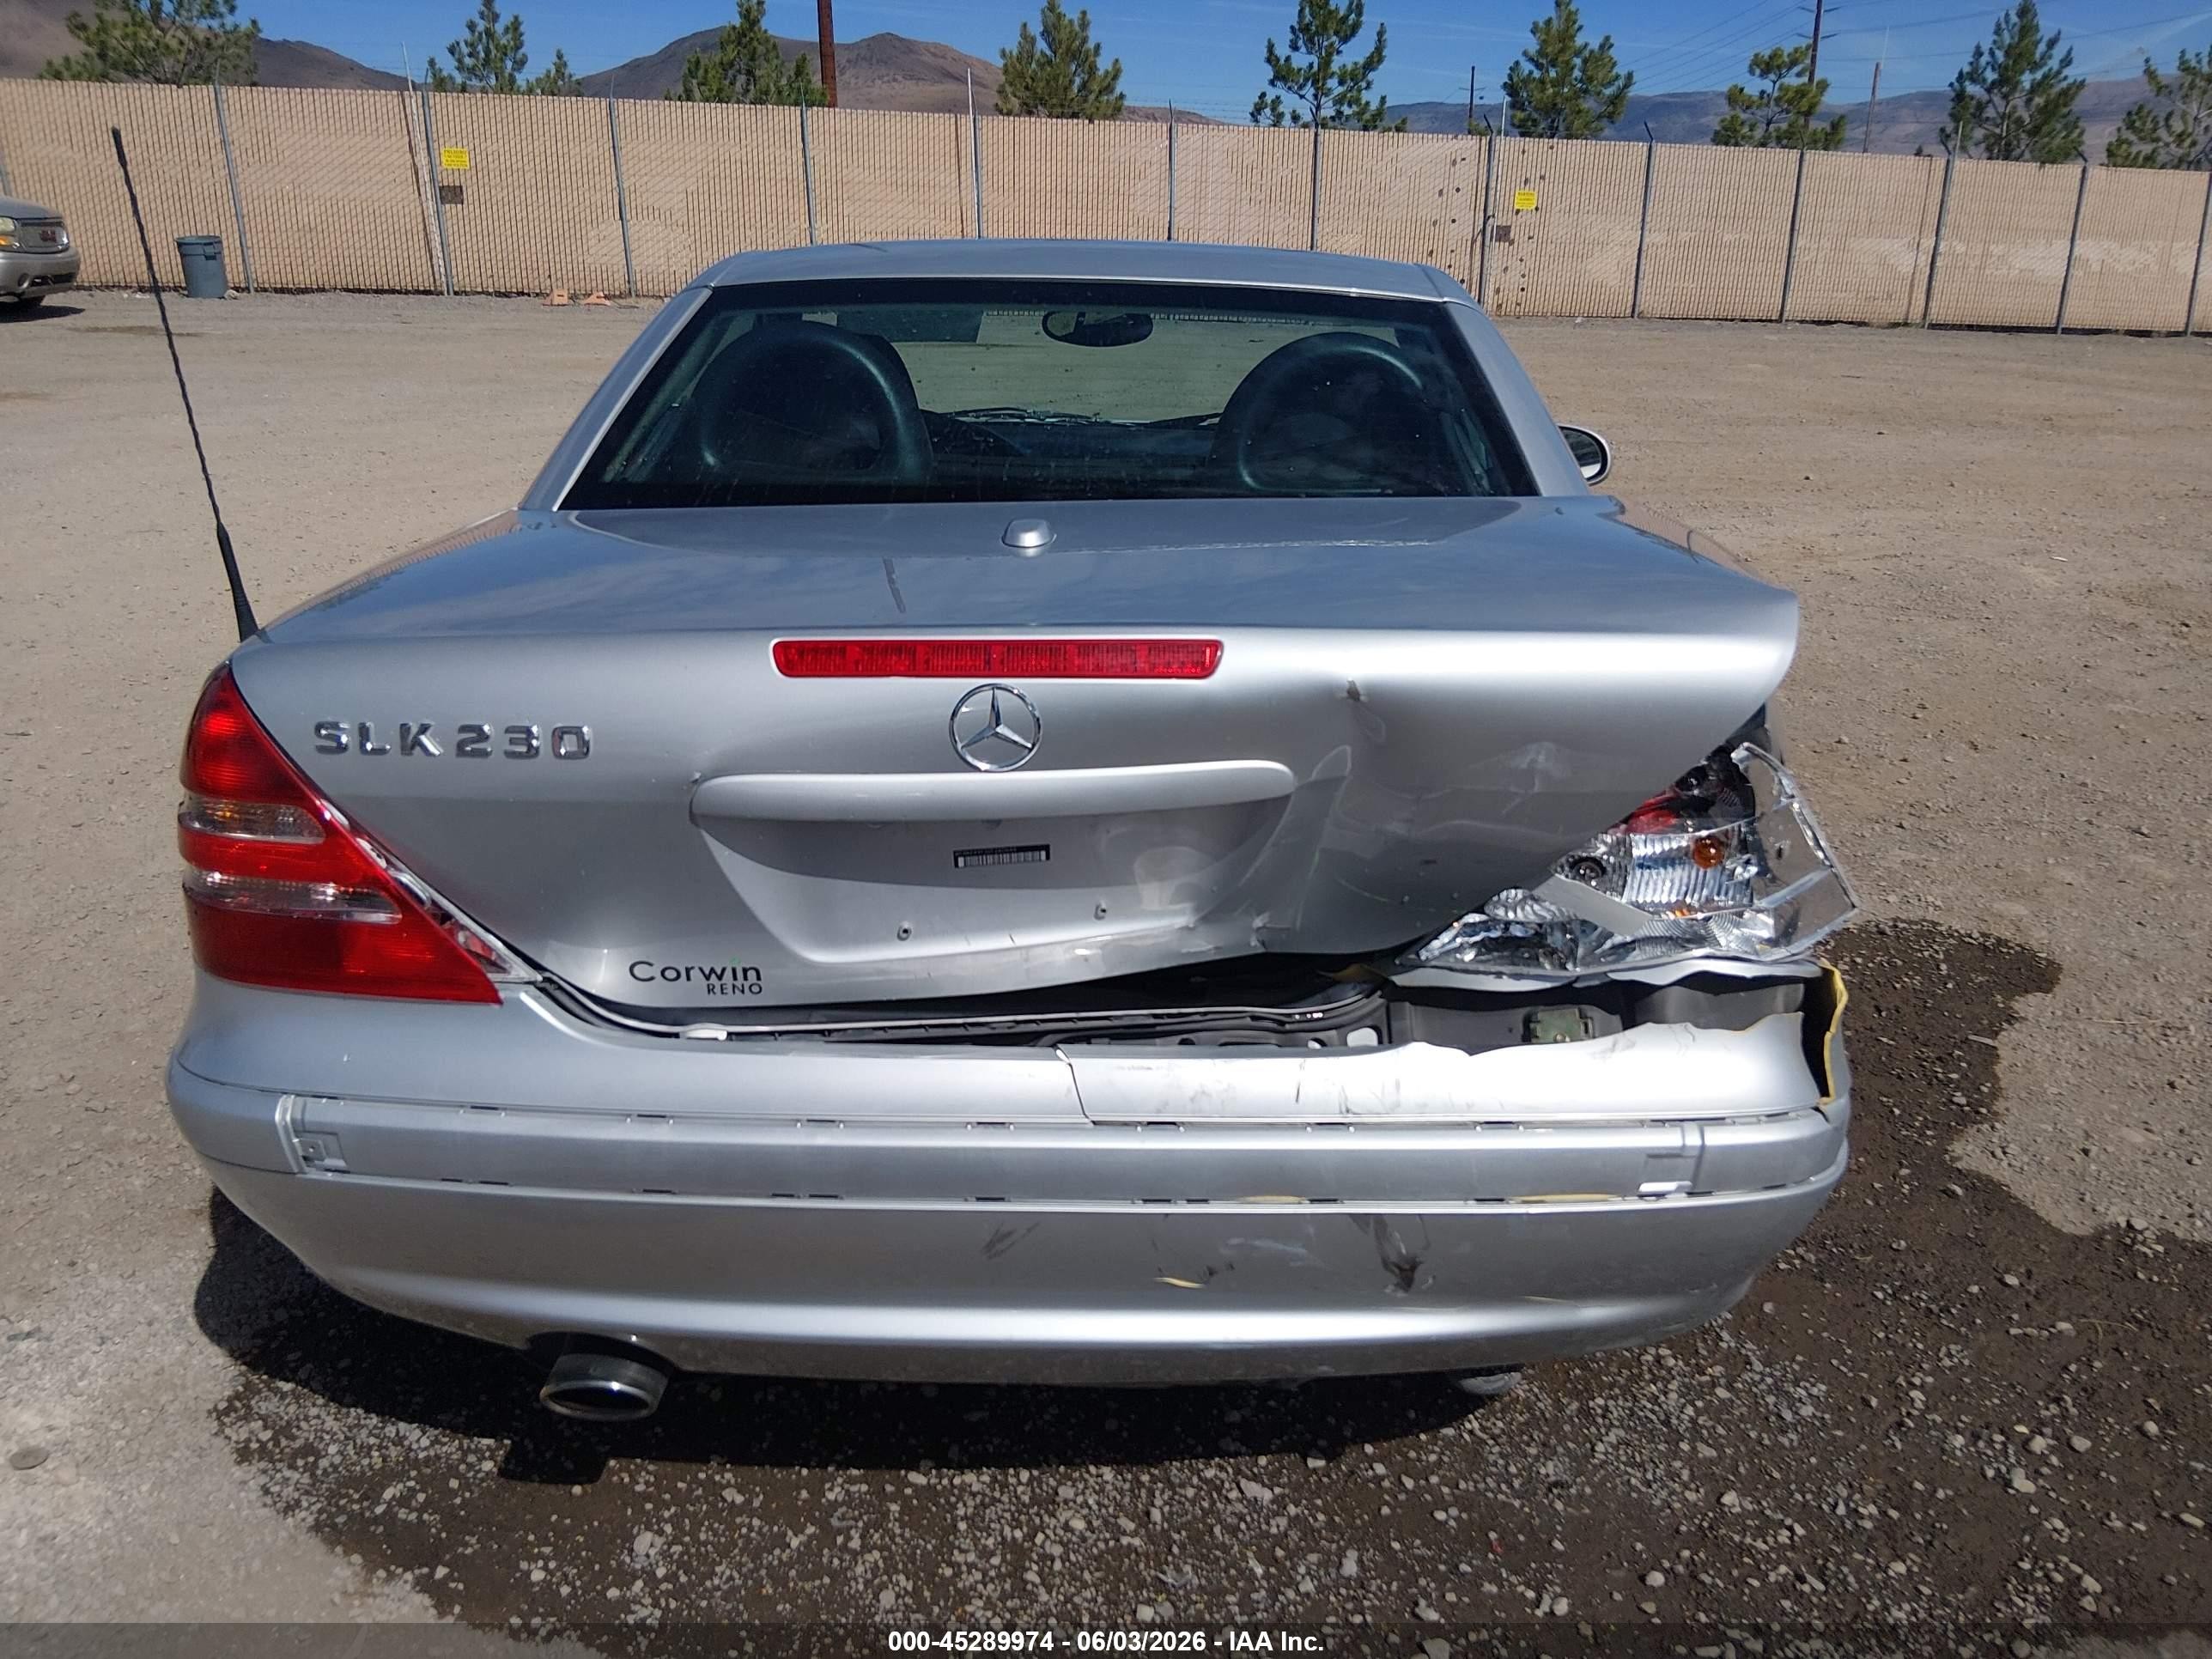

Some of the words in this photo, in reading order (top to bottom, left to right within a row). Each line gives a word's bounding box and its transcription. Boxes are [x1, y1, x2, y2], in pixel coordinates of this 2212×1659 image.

[314, 721, 444, 757] SLK
[455, 723, 592, 760] 230
[629, 957, 763, 982] Corwin
[707, 982, 763, 995] RENO
